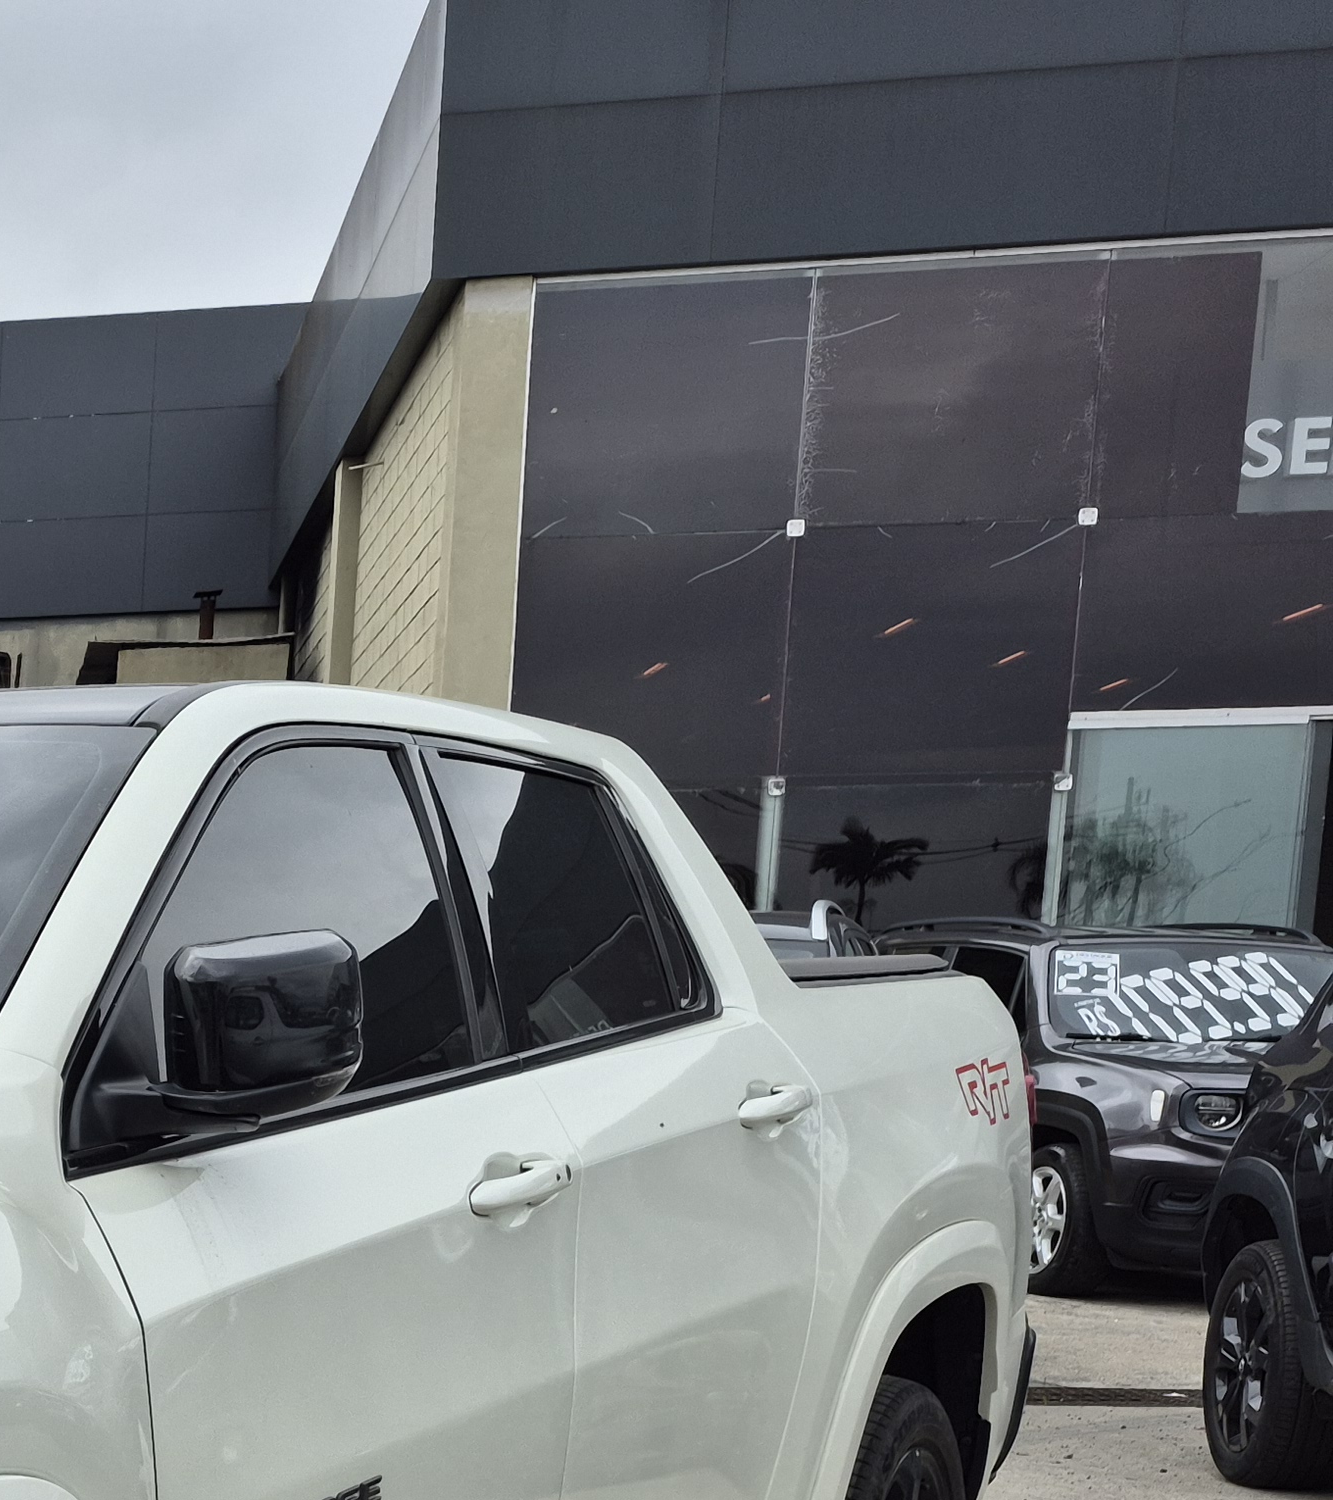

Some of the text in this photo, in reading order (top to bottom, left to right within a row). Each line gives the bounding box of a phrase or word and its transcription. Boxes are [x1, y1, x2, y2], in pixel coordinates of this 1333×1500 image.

[1241, 415, 1333, 478] SE
[1058, 960, 1117, 994] 23
[955, 1057, 1010, 1126] R/T
